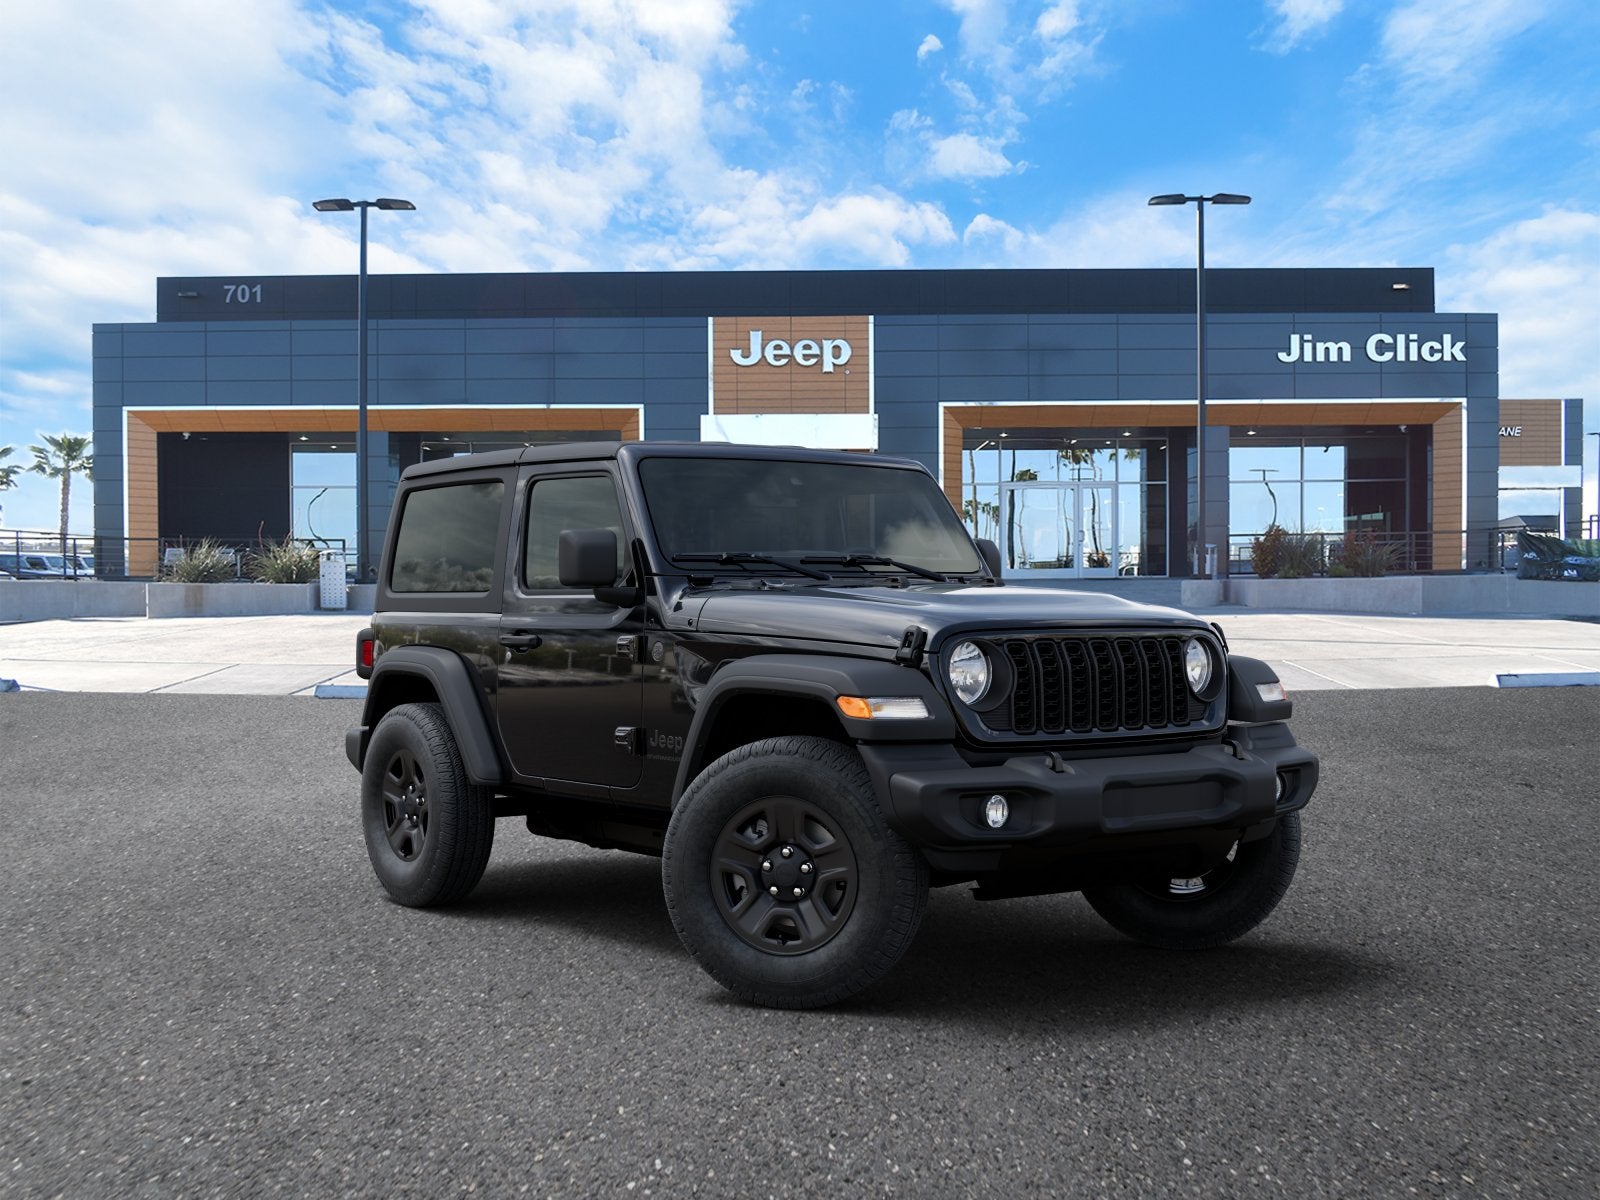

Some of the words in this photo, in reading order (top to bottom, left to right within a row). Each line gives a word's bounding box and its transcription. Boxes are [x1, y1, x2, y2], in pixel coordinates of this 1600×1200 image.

[223, 284, 263, 304] 701
[729, 329, 852, 373] Jeep
[1277, 332, 1352, 363] Jim
[1365, 332, 1467, 363] Click
[649, 729, 683, 754] Jeep
